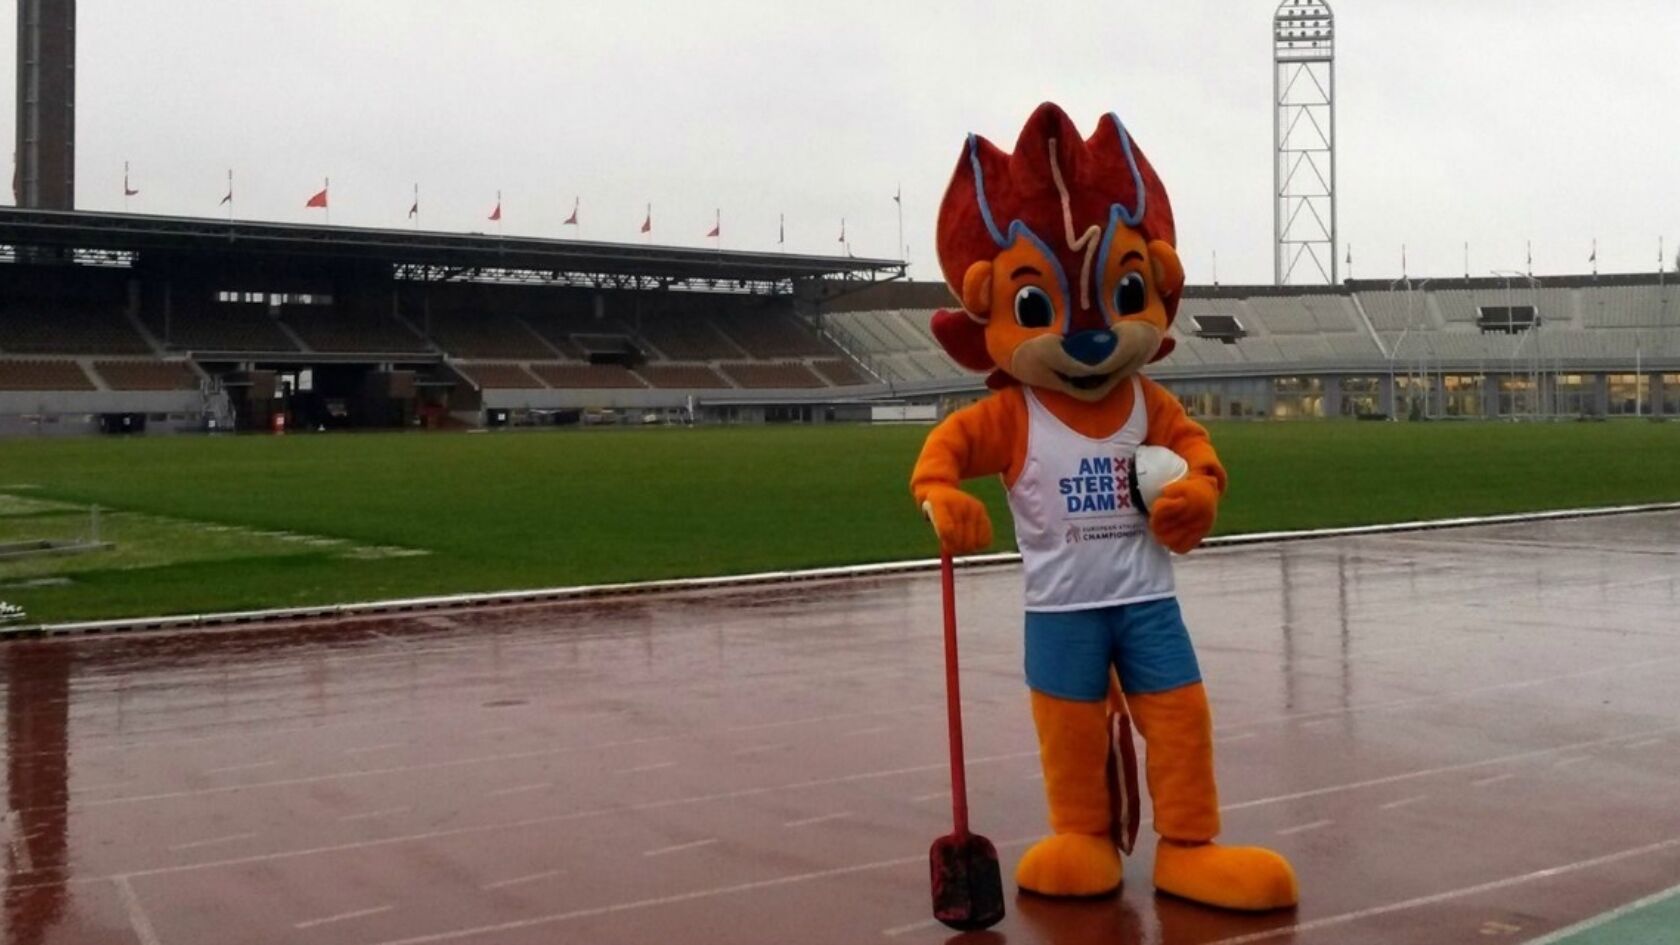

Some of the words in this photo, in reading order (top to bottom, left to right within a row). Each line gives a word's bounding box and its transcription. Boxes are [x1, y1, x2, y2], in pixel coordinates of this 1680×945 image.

[1079, 457, 1112, 475] AM
[1059, 476, 1114, 494] STER
[1067, 494, 1115, 512] DAM
